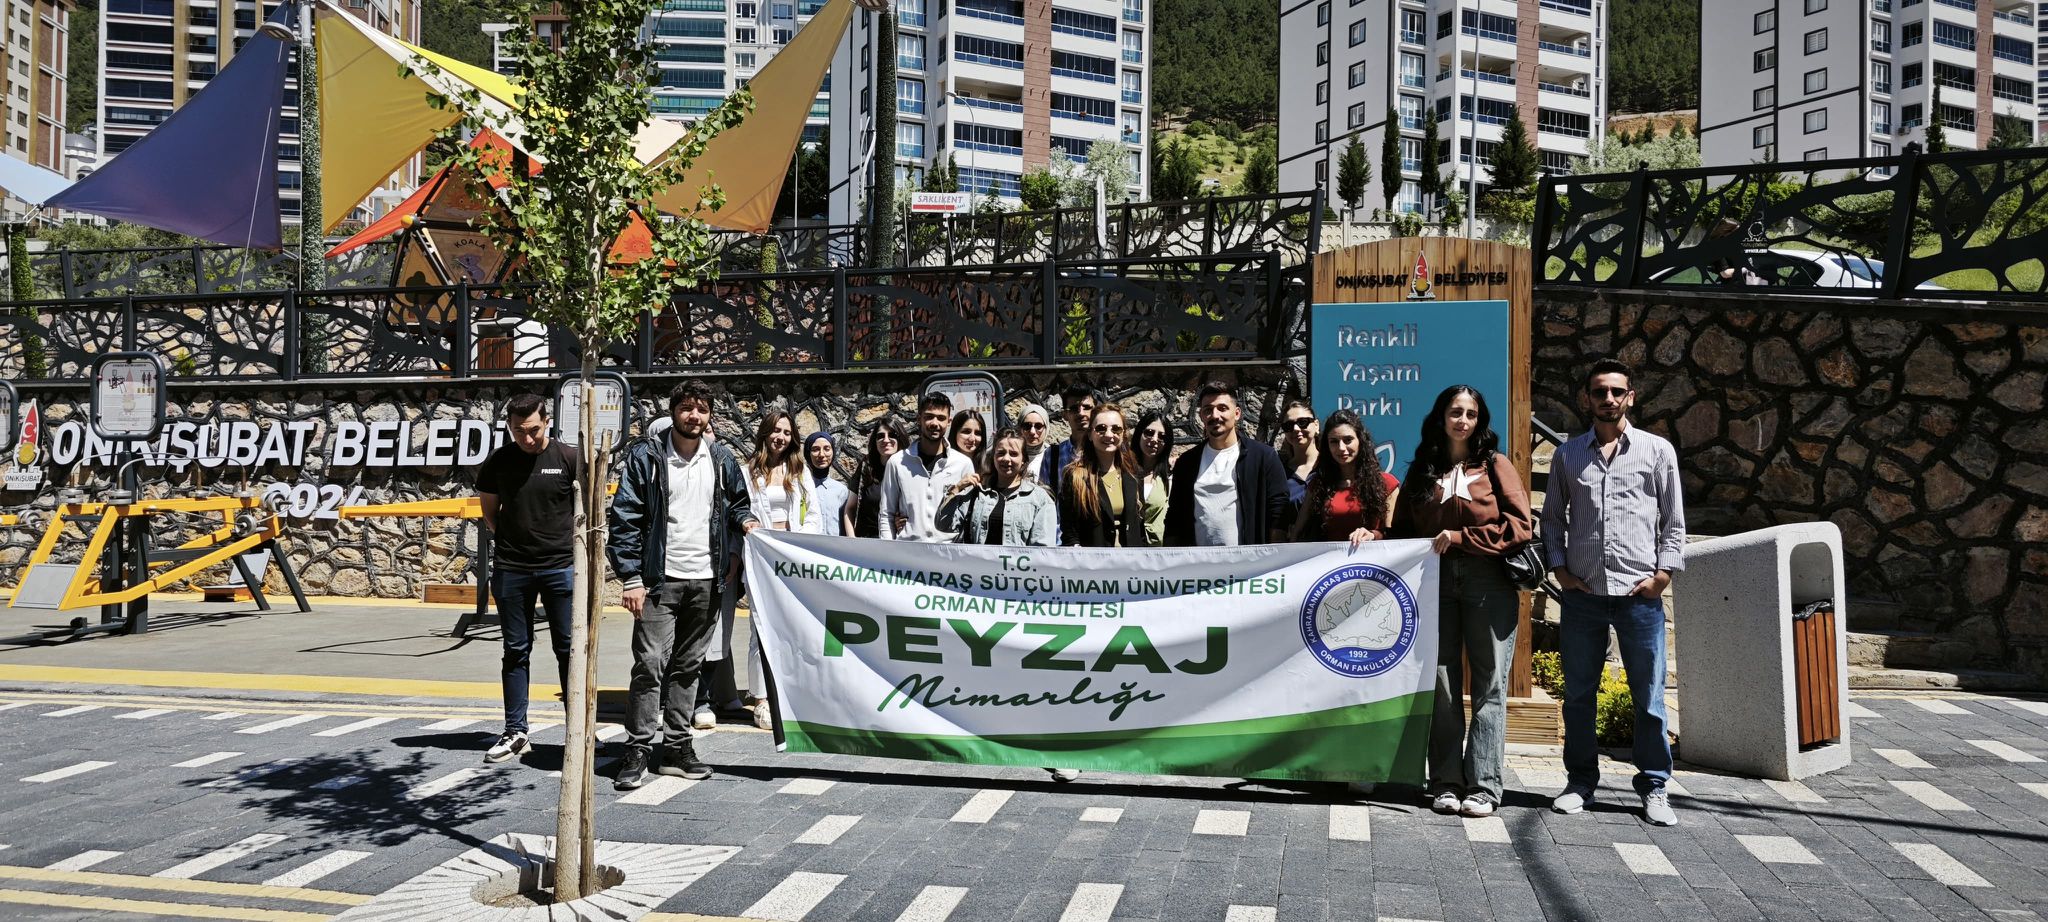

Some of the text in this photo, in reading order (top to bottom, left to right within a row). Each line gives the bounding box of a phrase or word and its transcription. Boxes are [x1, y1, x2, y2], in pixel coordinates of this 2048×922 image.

[917, 195, 963, 203] SAKLIKENT
[454, 238, 486, 250] KOALA
[1337, 323, 1418, 348] Renkli
[1338, 360, 1421, 386] Yaşam
[1337, 393, 1403, 416] Parkı
[333, 420, 612, 467] BELEDİ
[998, 555, 1037, 572] T.C.
[774, 560, 1286, 596] KAHRAMANMARAŞ SÜTÇÜ İMAM ÜNİVERSİTESİ
[914, 594, 1125, 619] ORMAN FAKÜLTESİ
[1305, 569, 1415, 647] KAHRAMANMARAŞ SÜTÇÜ İMAM ÜNİVERSİTESİ
[823, 609, 1230, 675] PEYZAJ
[1348, 650, 1368, 658] 1992
[1320, 649, 1398, 672] ORMAN FAKÜLTESİ
[876, 672, 1167, 722] Mimarlığı
